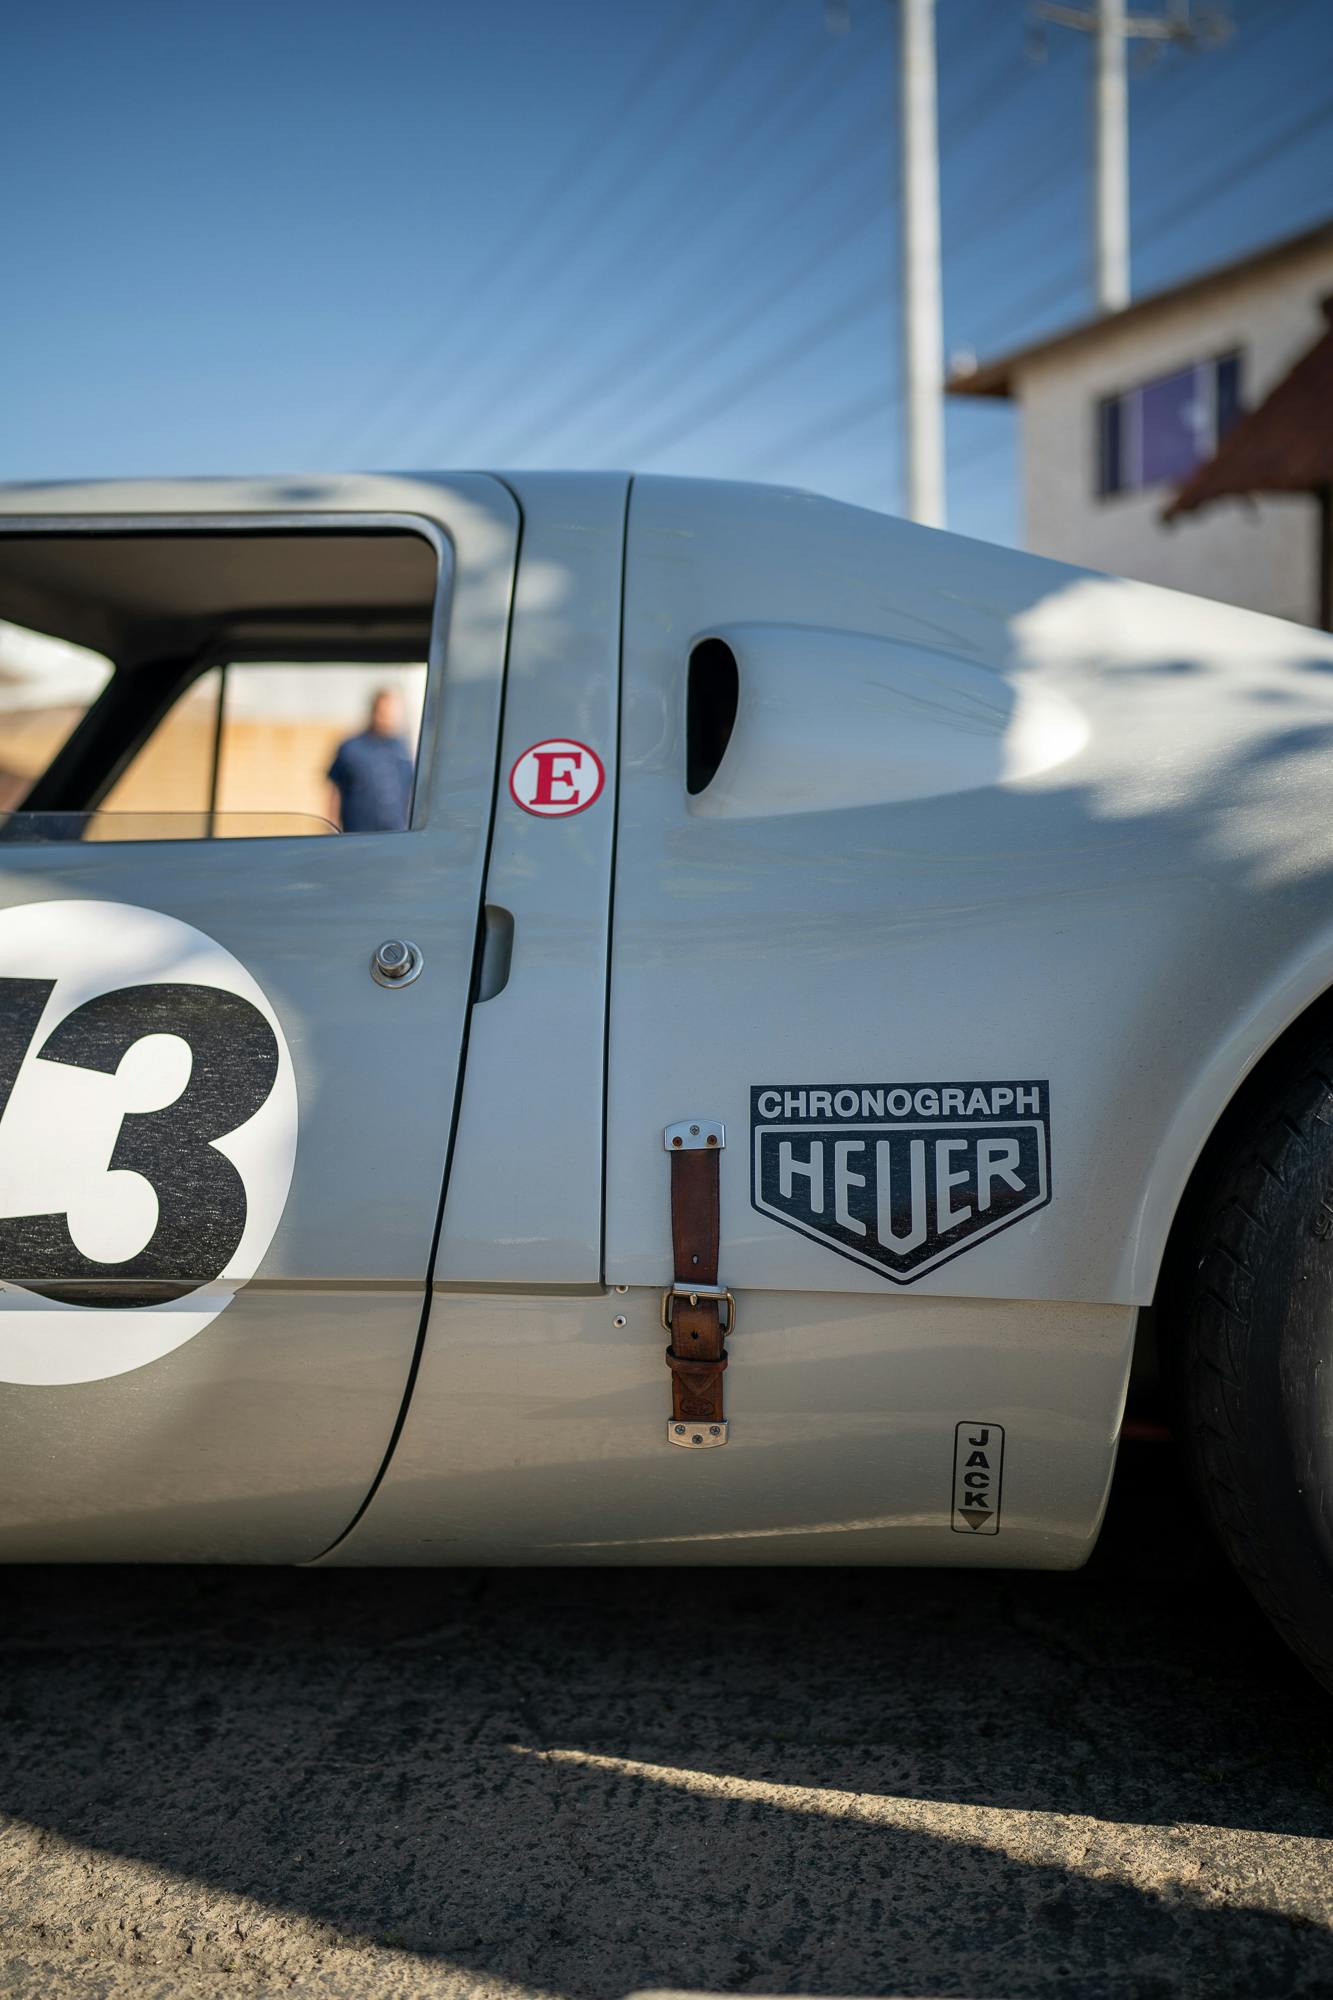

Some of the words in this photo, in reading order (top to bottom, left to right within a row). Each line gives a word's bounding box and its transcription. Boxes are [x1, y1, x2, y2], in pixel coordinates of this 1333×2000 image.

[529, 752, 582, 805] E
[757, 1086, 1040, 1119] CHRONOGRAPH
[779, 1138, 1026, 1255] HEUER
[963, 1428, 991, 1508] JACK
